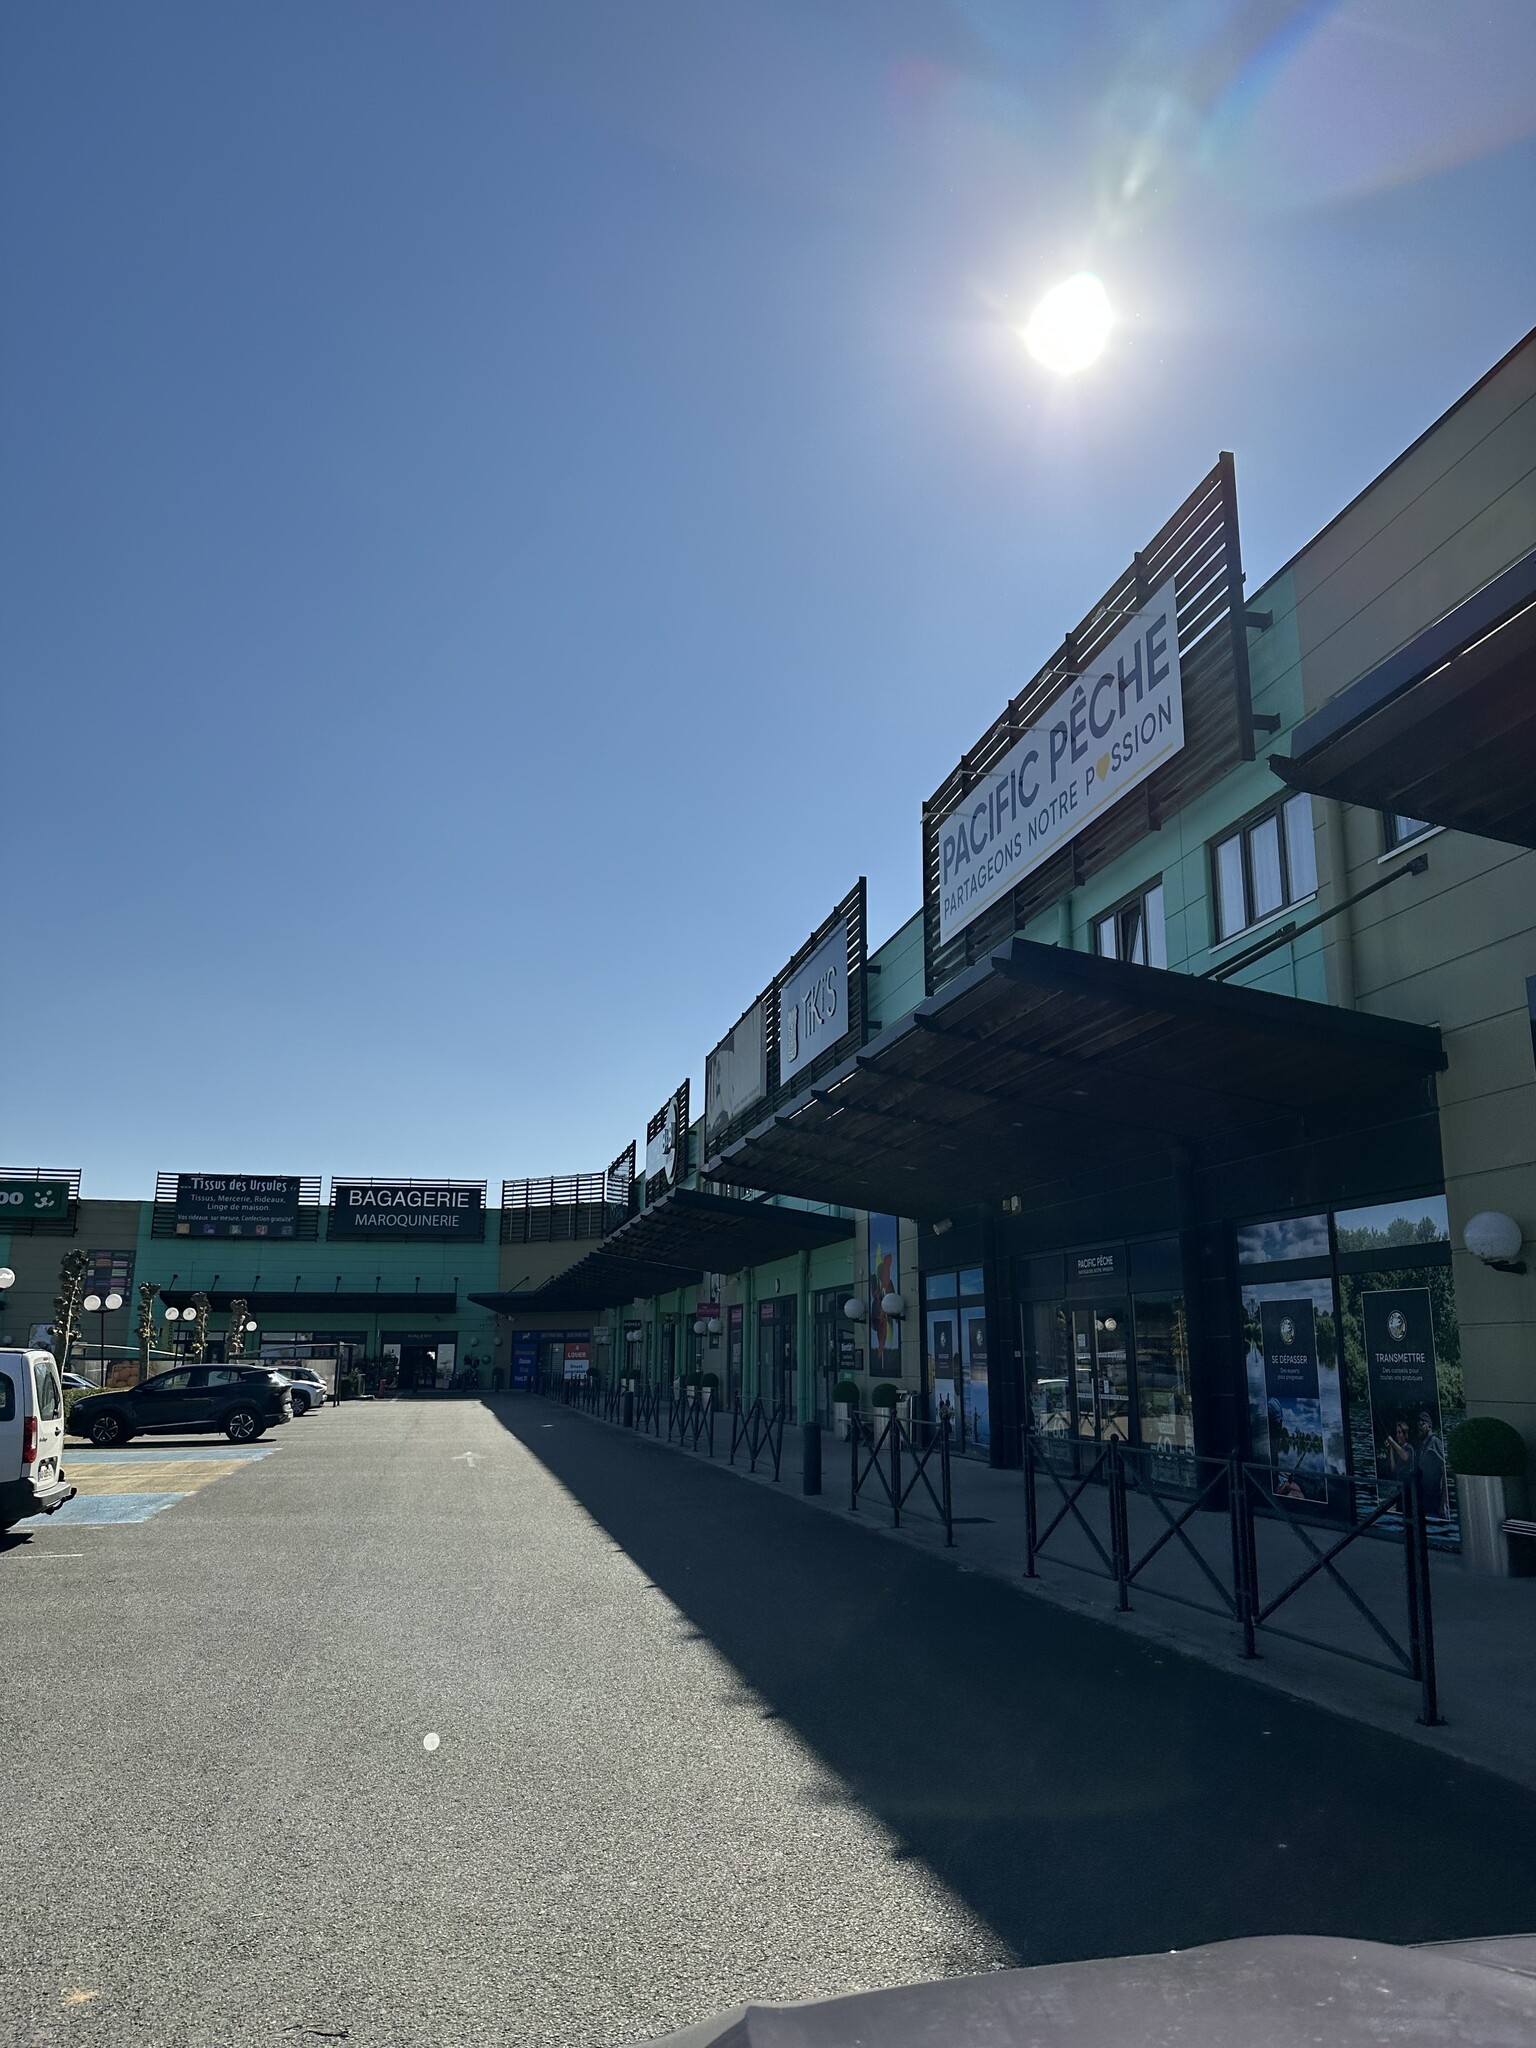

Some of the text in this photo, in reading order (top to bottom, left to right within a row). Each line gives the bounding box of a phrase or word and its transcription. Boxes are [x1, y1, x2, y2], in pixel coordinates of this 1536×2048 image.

[943, 612, 1170, 886] PACIFIC PÊCHE
[943, 832, 1022, 921] PARTAGEONS
[1028, 780, 1078, 850] NOTRE
[229, 1178, 247, 1191] des
[250, 1179, 287, 1193] Ursules
[190, 1194, 287, 1203] Tissus, Mercerie, Rideaux,
[349, 1189, 470, 1208] BAGAGERIE
[207, 1203, 229, 1212] Linge
[230, 1203, 240, 1211] de
[241, 1214, 270, 1222] Confection
[354, 1213, 460, 1227] MAROQUINERIE
[1077, 1257, 1096, 1269] PACIFIC
[1271, 1353, 1308, 1364] SE DÉPASSER
[1375, 1352, 1426, 1363] TRANSMETTRE
